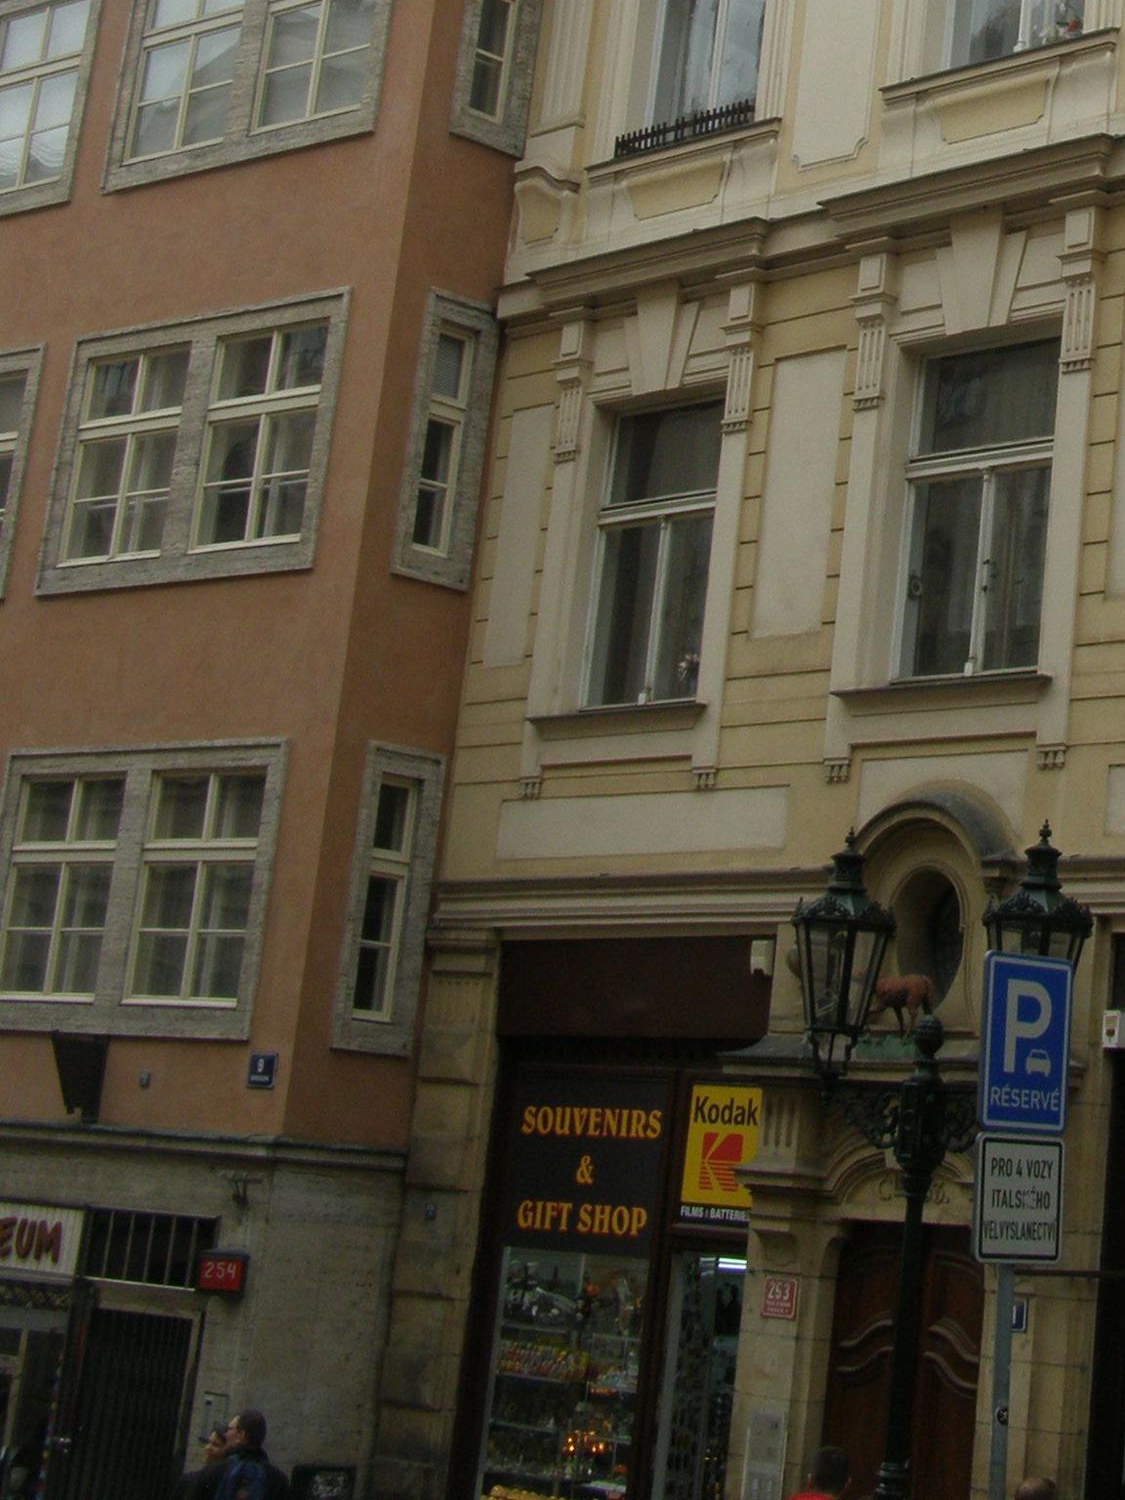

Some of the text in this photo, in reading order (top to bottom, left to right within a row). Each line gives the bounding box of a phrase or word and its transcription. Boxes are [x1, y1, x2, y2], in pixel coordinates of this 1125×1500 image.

[1004, 978, 1052, 1073] P
[694, 1095, 758, 1126] Kodak
[990, 1084, 1060, 1111] RÉSERVÉ
[521, 1106, 663, 1139] SOUVENIRS
[575, 1155, 594, 1184] &
[991, 1157, 1053, 1179] PRO 4 VOZY
[517, 1200, 648, 1236] GIFT SHOP
[204, 1261, 236, 1279] 254
[768, 1282, 791, 1300] 253
